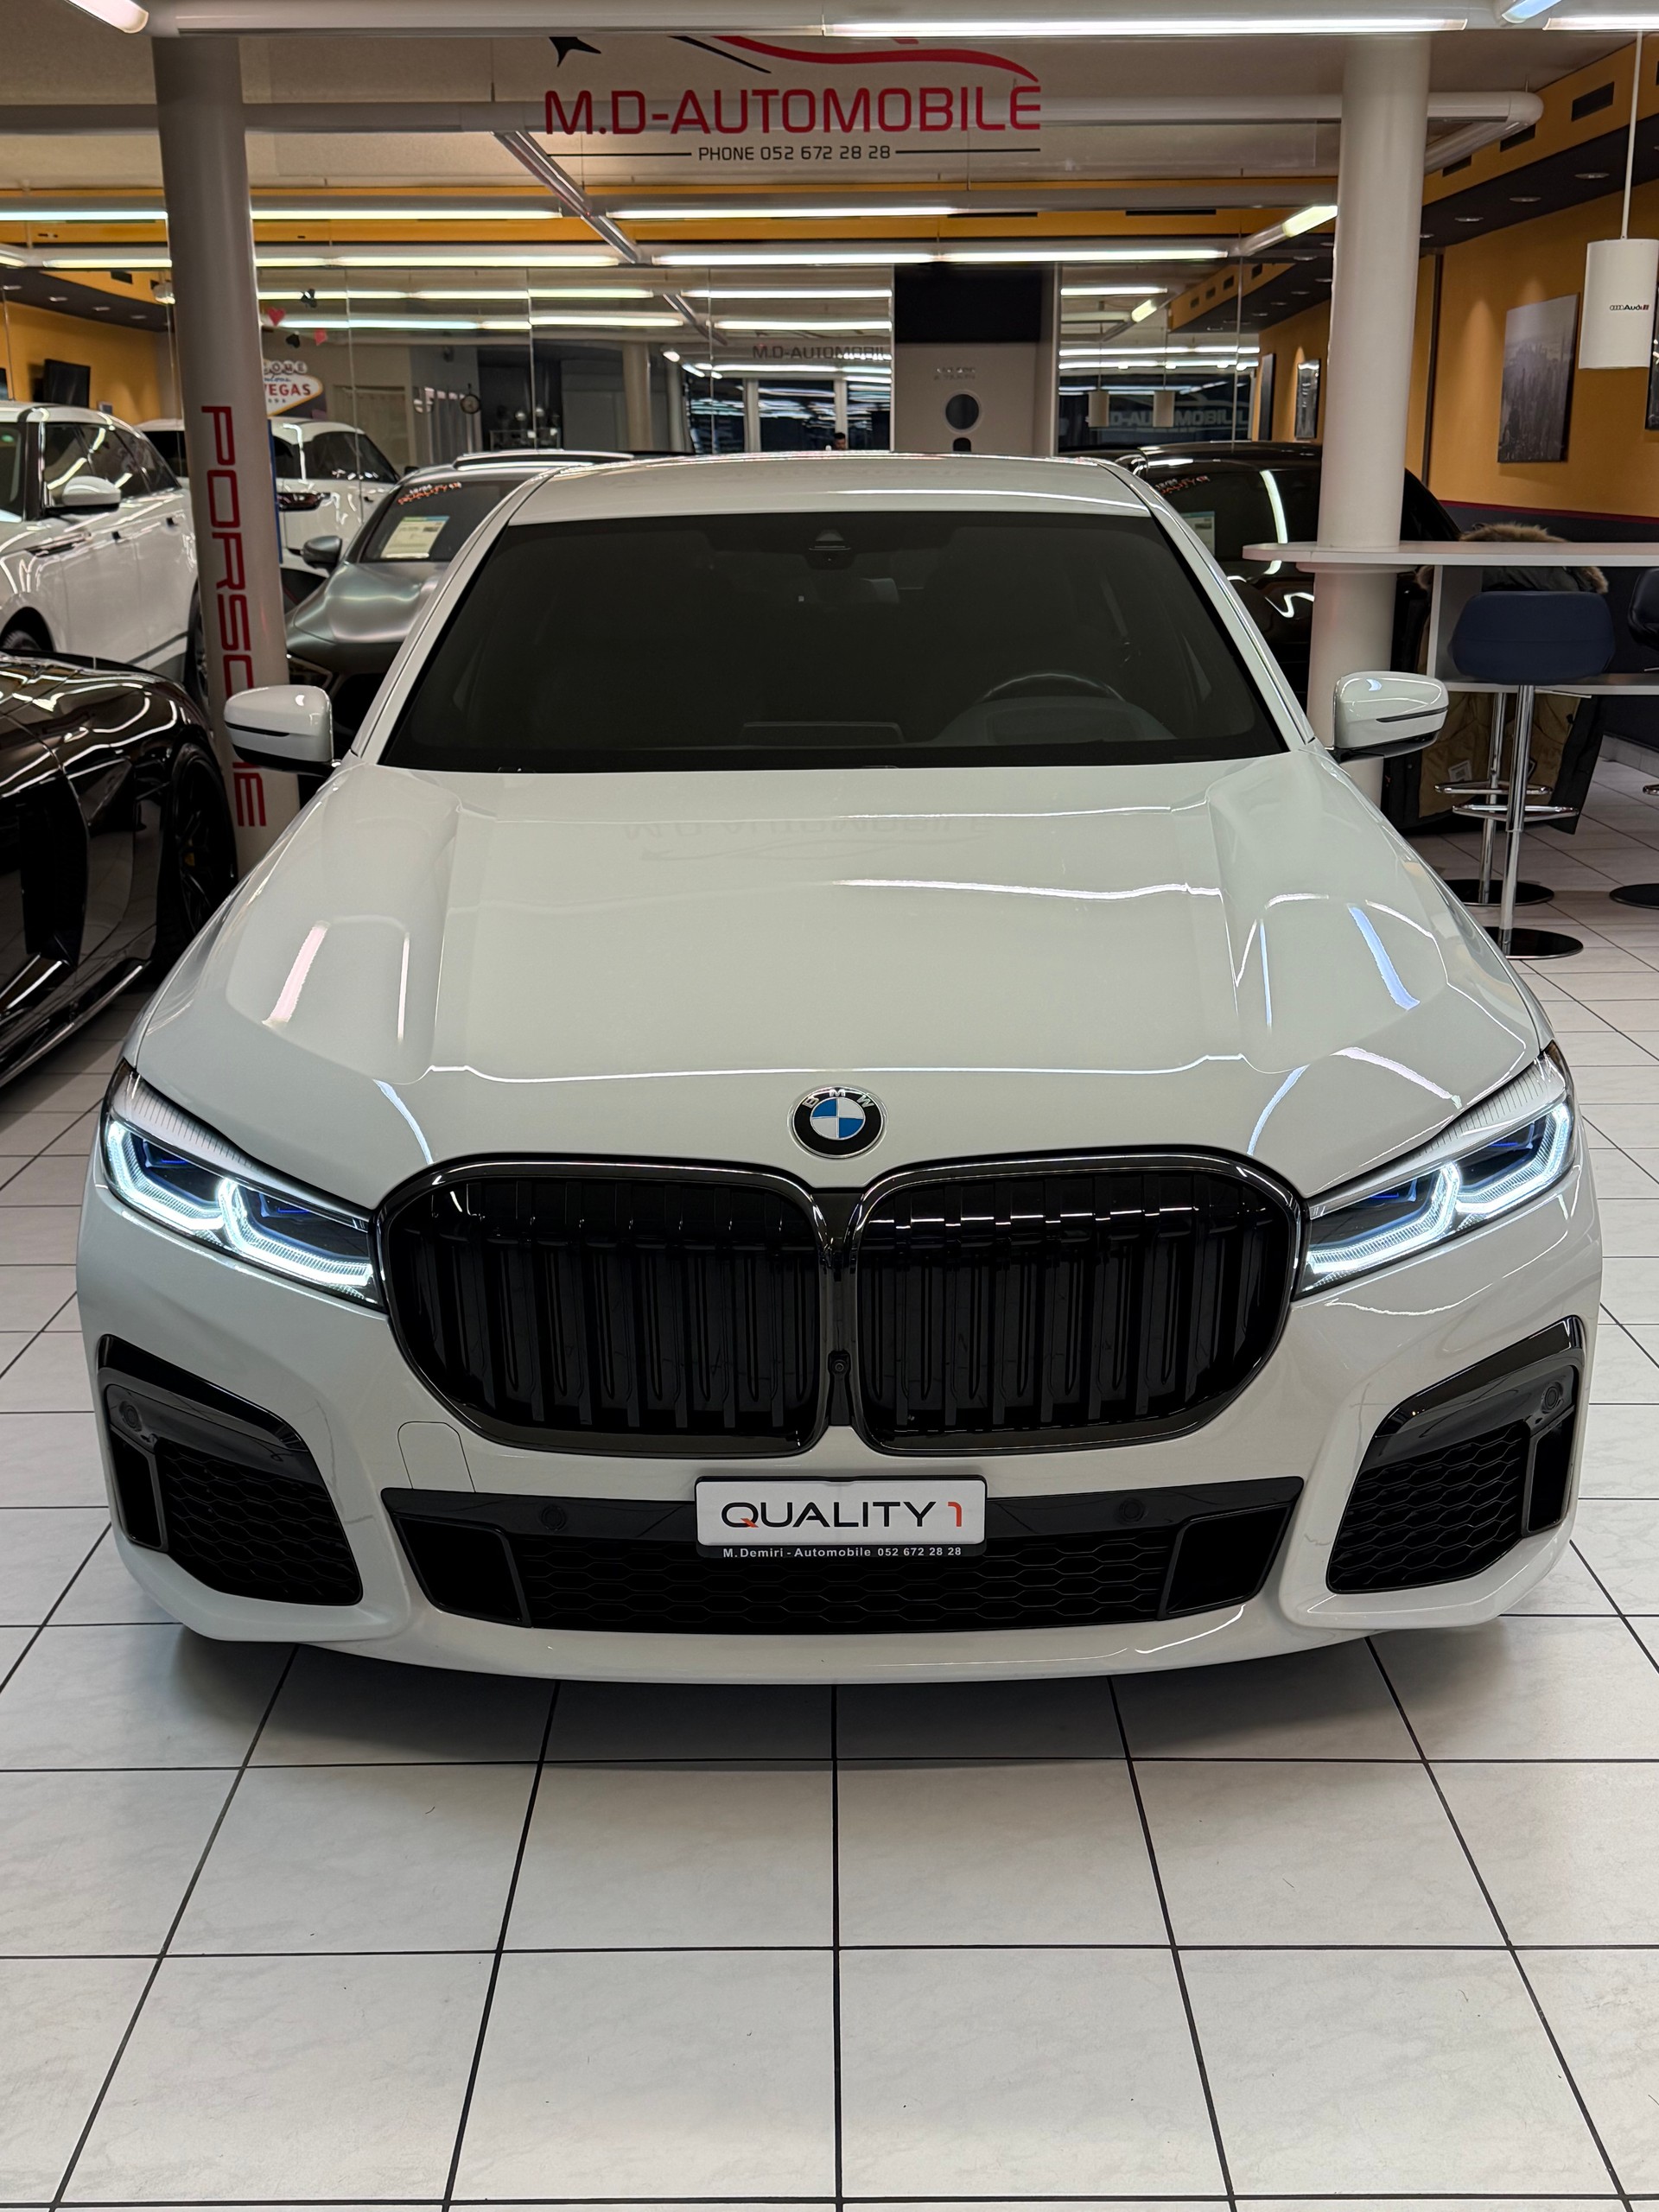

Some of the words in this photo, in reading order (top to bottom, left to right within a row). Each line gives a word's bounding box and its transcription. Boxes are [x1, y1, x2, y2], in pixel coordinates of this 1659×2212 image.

[545, 86, 1041, 135] M.D-AUTOMOBILE
[698, 147, 754, 161] PHONE
[760, 147, 794, 160] 052
[801, 146, 832, 160] 672
[840, 146, 861, 159] 28
[868, 145, 890, 159] 28
[201, 405, 267, 828] PORSCE
[802, 1088, 875, 1109] BMW
[721, 1501, 937, 1529] QUALITY
[947, 1501, 963, 1528] 1
[794, 1548, 871, 1558] Automobile
[877, 1548, 899, 1556] 052
[903, 1547, 925, 1556] 672
[929, 1547, 943, 1556] 28
[947, 1547, 962, 1556] 28
